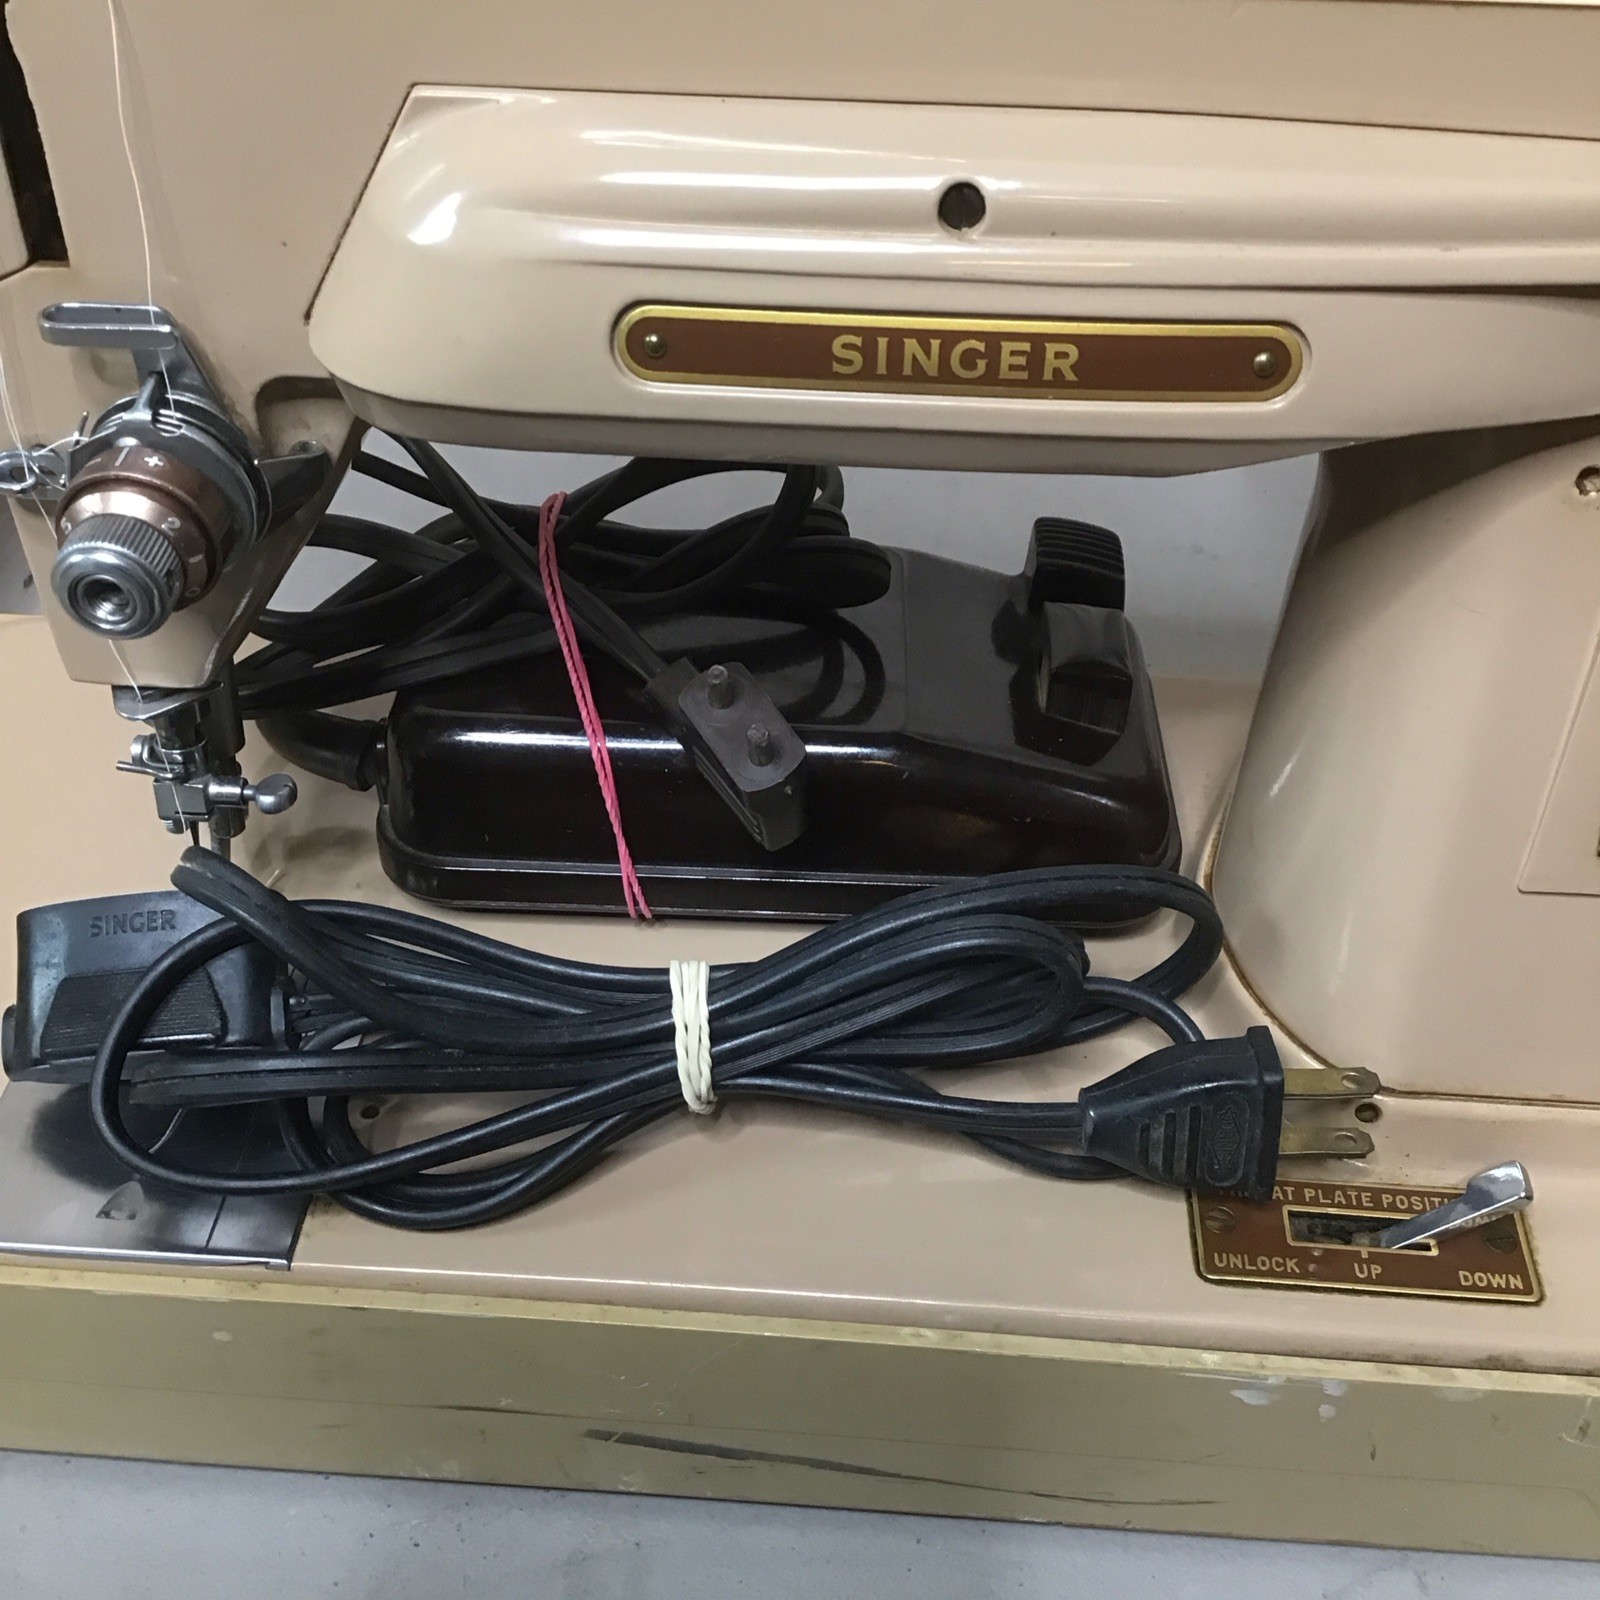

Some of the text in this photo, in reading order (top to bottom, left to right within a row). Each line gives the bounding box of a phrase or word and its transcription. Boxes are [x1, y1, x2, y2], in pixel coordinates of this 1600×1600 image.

[832, 334, 1080, 382] SINGER
[161, 517, 181, 536] 2
[89, 909, 177, 938] SINGER
[1304, 1187, 1374, 1207] PLATE
[1383, 1191, 1449, 1211] POSIT
[1214, 1252, 1301, 1273] UNLOCK
[1354, 1262, 1383, 1279] UP
[1458, 1270, 1524, 1290] DOWN
